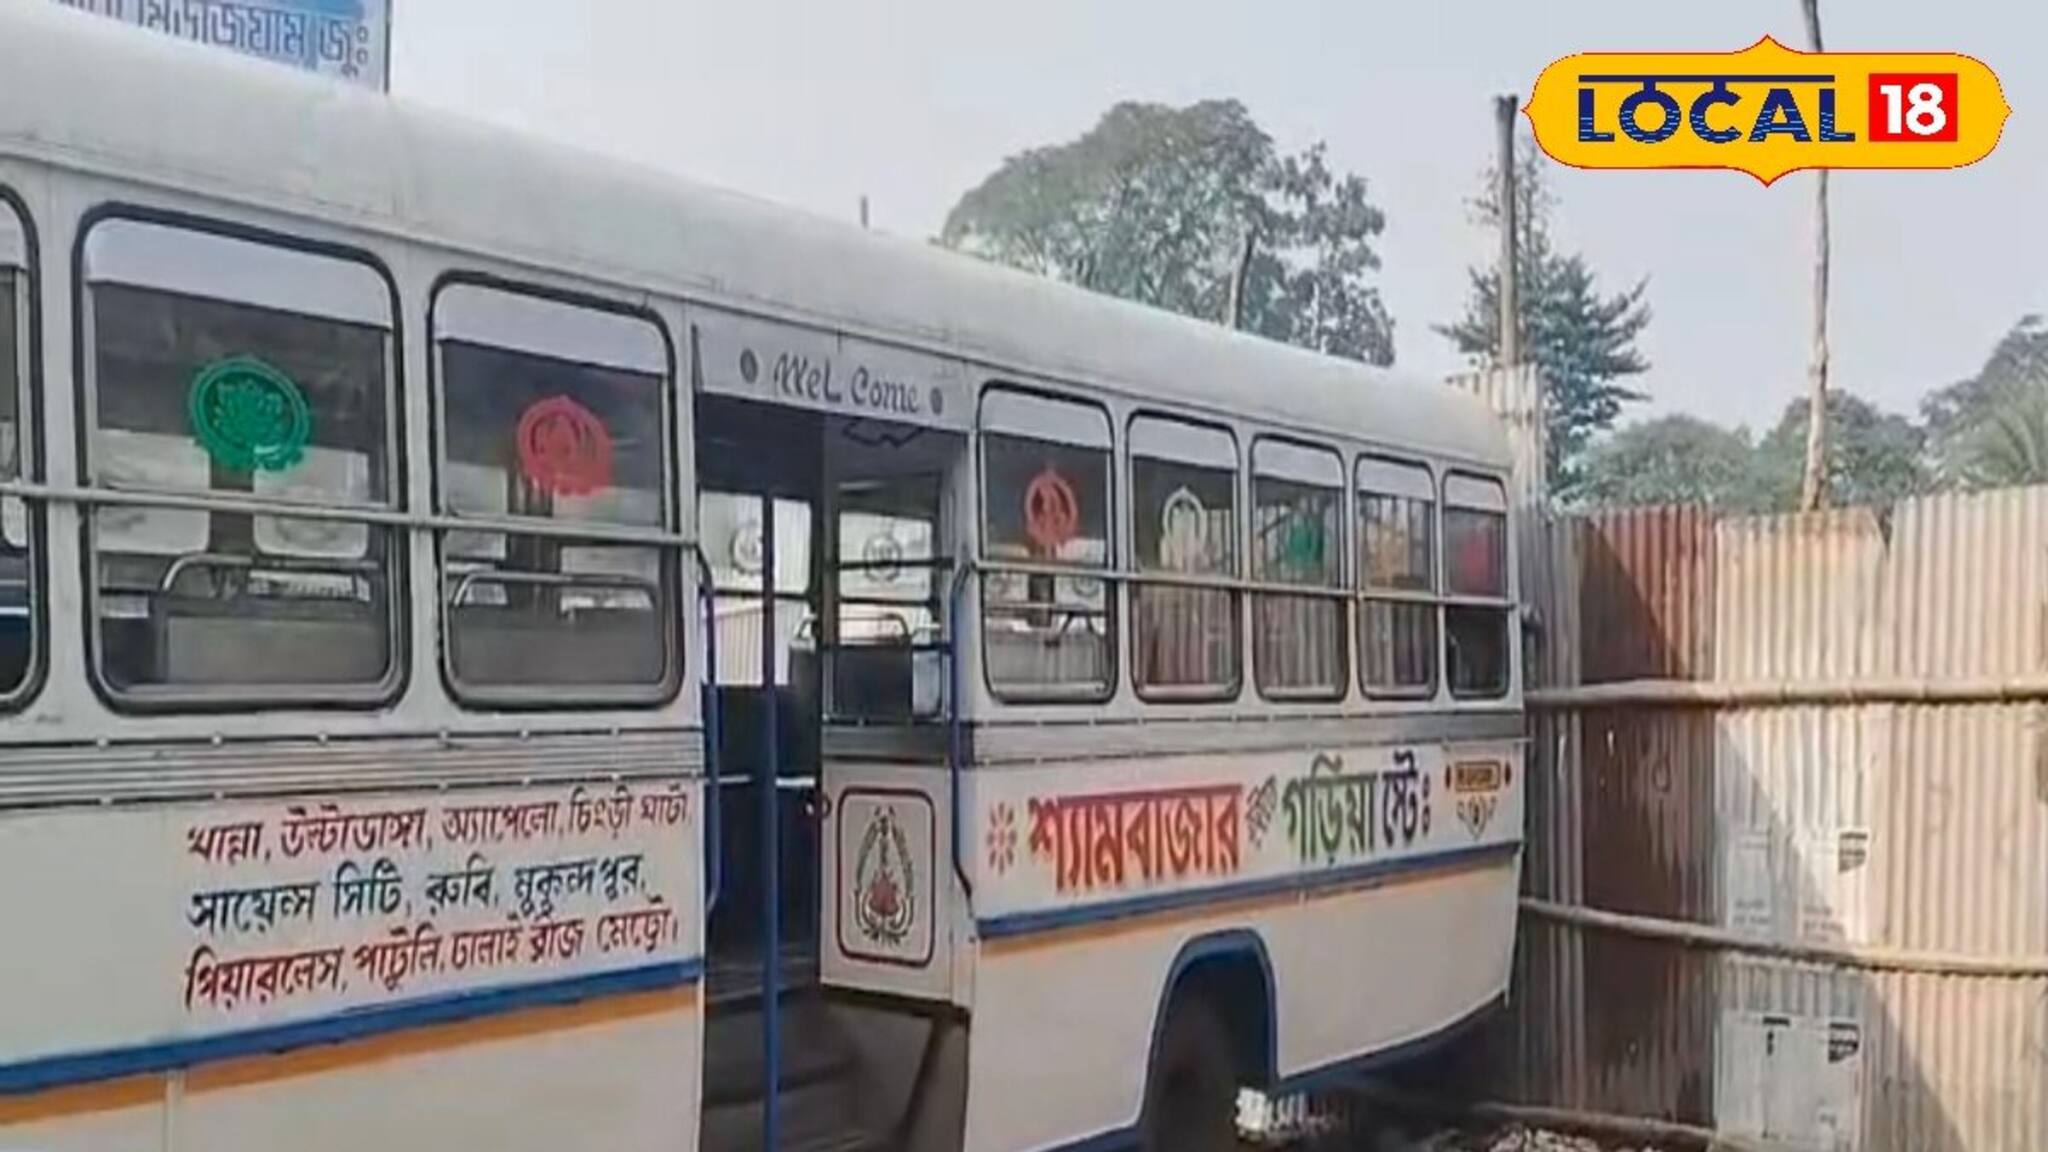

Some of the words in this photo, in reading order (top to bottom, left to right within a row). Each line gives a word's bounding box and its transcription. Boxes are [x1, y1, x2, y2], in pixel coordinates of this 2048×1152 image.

[851, 366, 918, 414] Come
[1028, 785, 1242, 890] শ্যামবাজার
[1282, 754, 1378, 864] গড়িয়া
